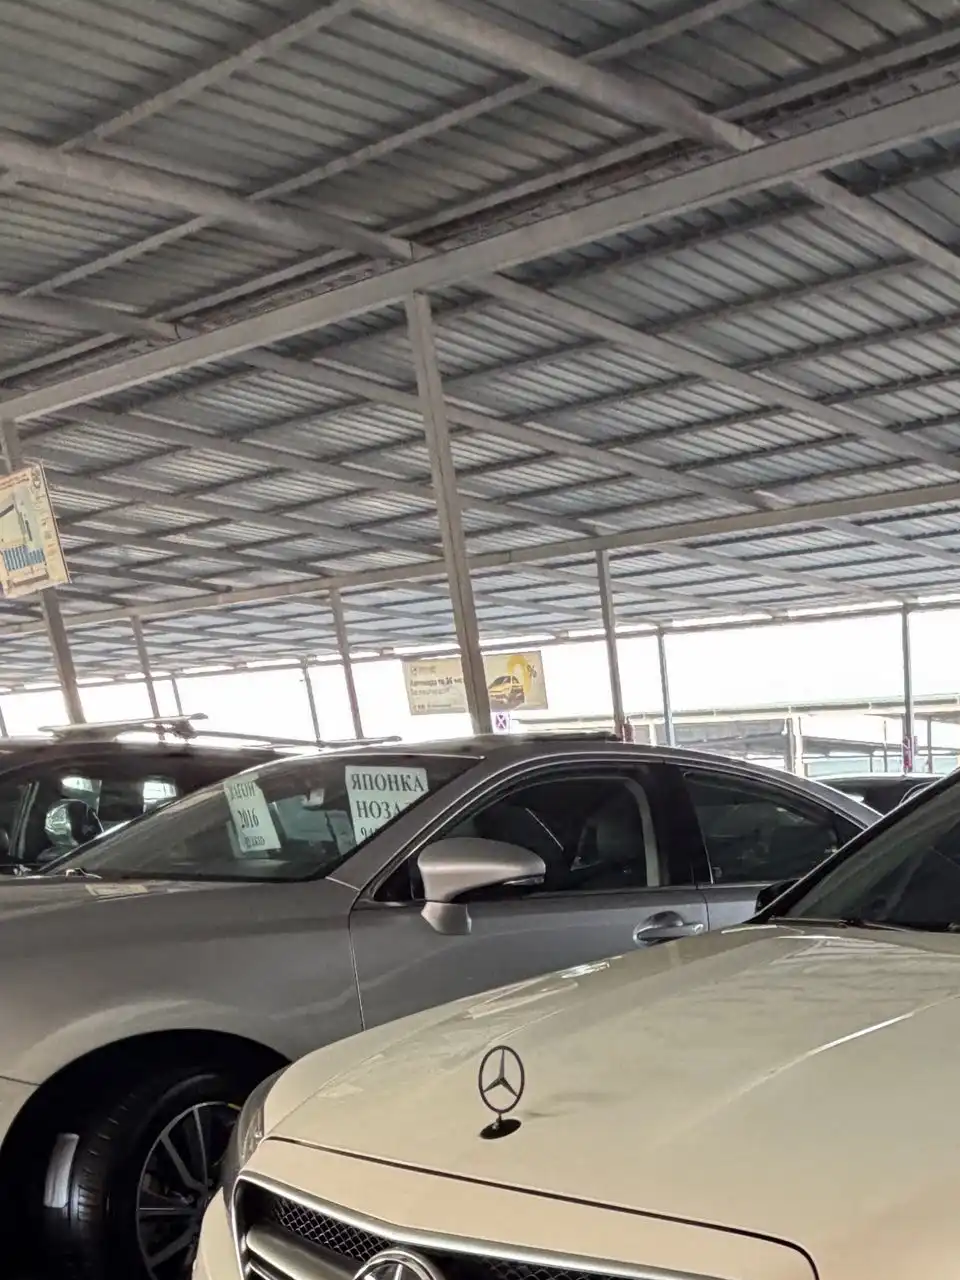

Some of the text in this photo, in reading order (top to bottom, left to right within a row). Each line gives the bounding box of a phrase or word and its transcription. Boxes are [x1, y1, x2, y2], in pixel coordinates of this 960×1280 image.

[351, 773, 425, 792] ЯПОНКА
[238, 808, 260, 829] 2016
[356, 800, 412, 819] НОЗА
